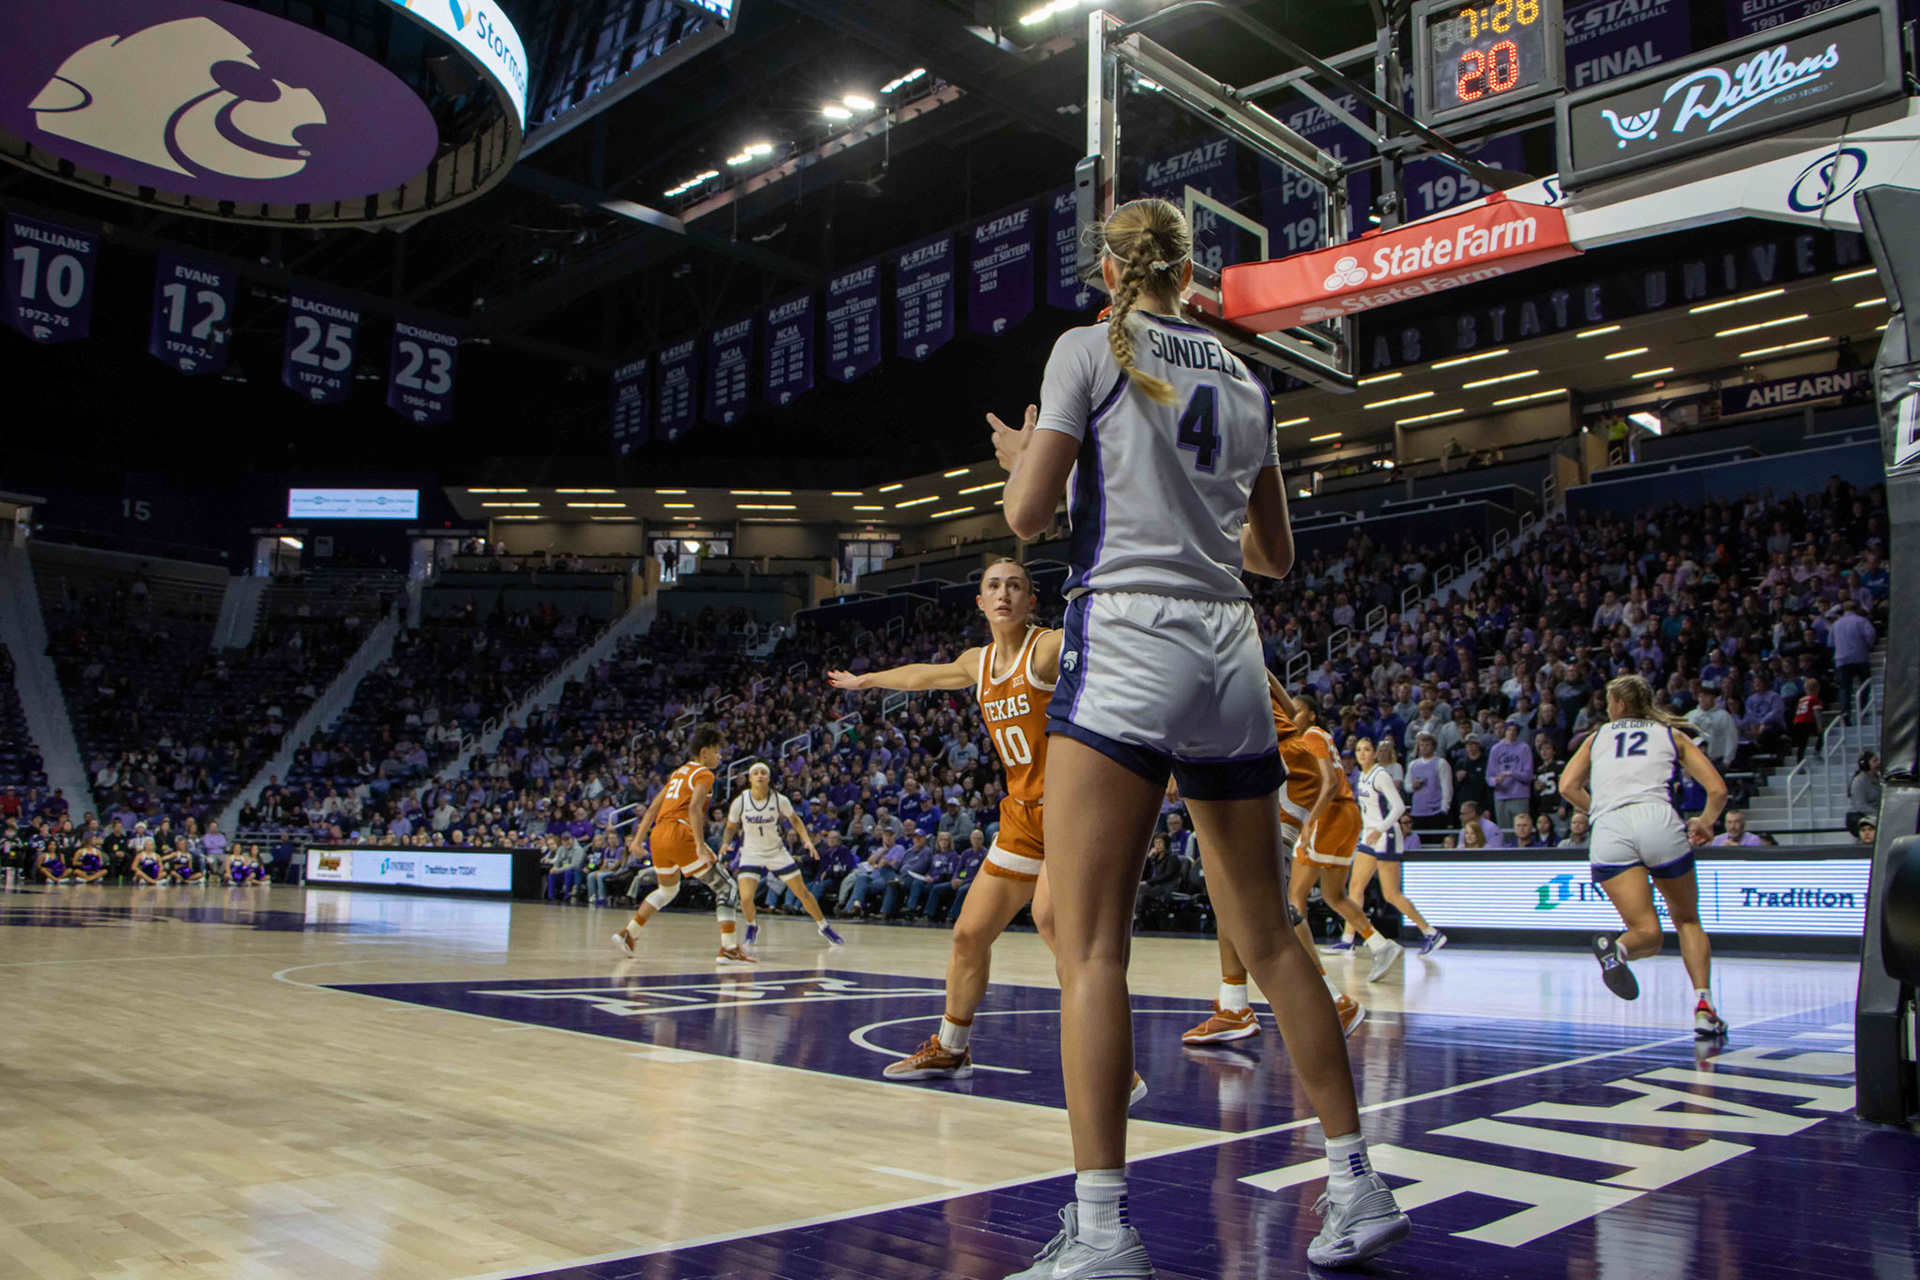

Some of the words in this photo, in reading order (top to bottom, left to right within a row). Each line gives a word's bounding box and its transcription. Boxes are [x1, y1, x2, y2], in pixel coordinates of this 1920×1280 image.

[1564, 0, 1672, 37] K-STAT
[1599, 5, 1668, 35] BASKETBALL
[1751, 13, 1785, 32] 1981
[1458, 40, 1518, 101] 20
[1574, 40, 1662, 88] FINAL
[1663, 43, 1839, 132] Dillons
[1146, 138, 1229, 182] K-STATE
[13, 223, 90, 254] WILLIAMS
[975, 208, 1030, 240] K-STATE
[1057, 225, 1077, 242] ELIT
[900, 238, 949, 267] K-STATE
[973, 254, 999, 271] SWEET
[999, 241, 1031, 260] SIXTEEN
[1060, 244, 1076, 255] 195
[12, 245, 85, 308] 10
[175, 265, 221, 287] EVANS
[830, 265, 876, 292] K-STATE
[896, 282, 921, 298] SWEET
[921, 271, 951, 287] SIXTEEN
[18, 307, 70, 327] 1972-76
[163, 283, 226, 344] 12
[291, 296, 360, 323] BLACKMAN
[769, 296, 810, 321] K-STATE
[291, 315, 352, 372] 25
[396, 322, 458, 347] RICHMOND
[776, 324, 799, 341] NCAA
[396, 340, 452, 395] 23
[1148, 328, 1243, 381] SUNDELL
[1745, 371, 1853, 409] AHEARN
[1176, 383, 1222, 475] 4
[121, 498, 151, 521] 15
[983, 693, 1031, 722] TEXAS
[995, 725, 1032, 767] 10
[1614, 731, 1649, 759] 12
[665, 778, 684, 799] 21
[758, 825, 764, 837] 1
[1740, 886, 1857, 909] Tradition
